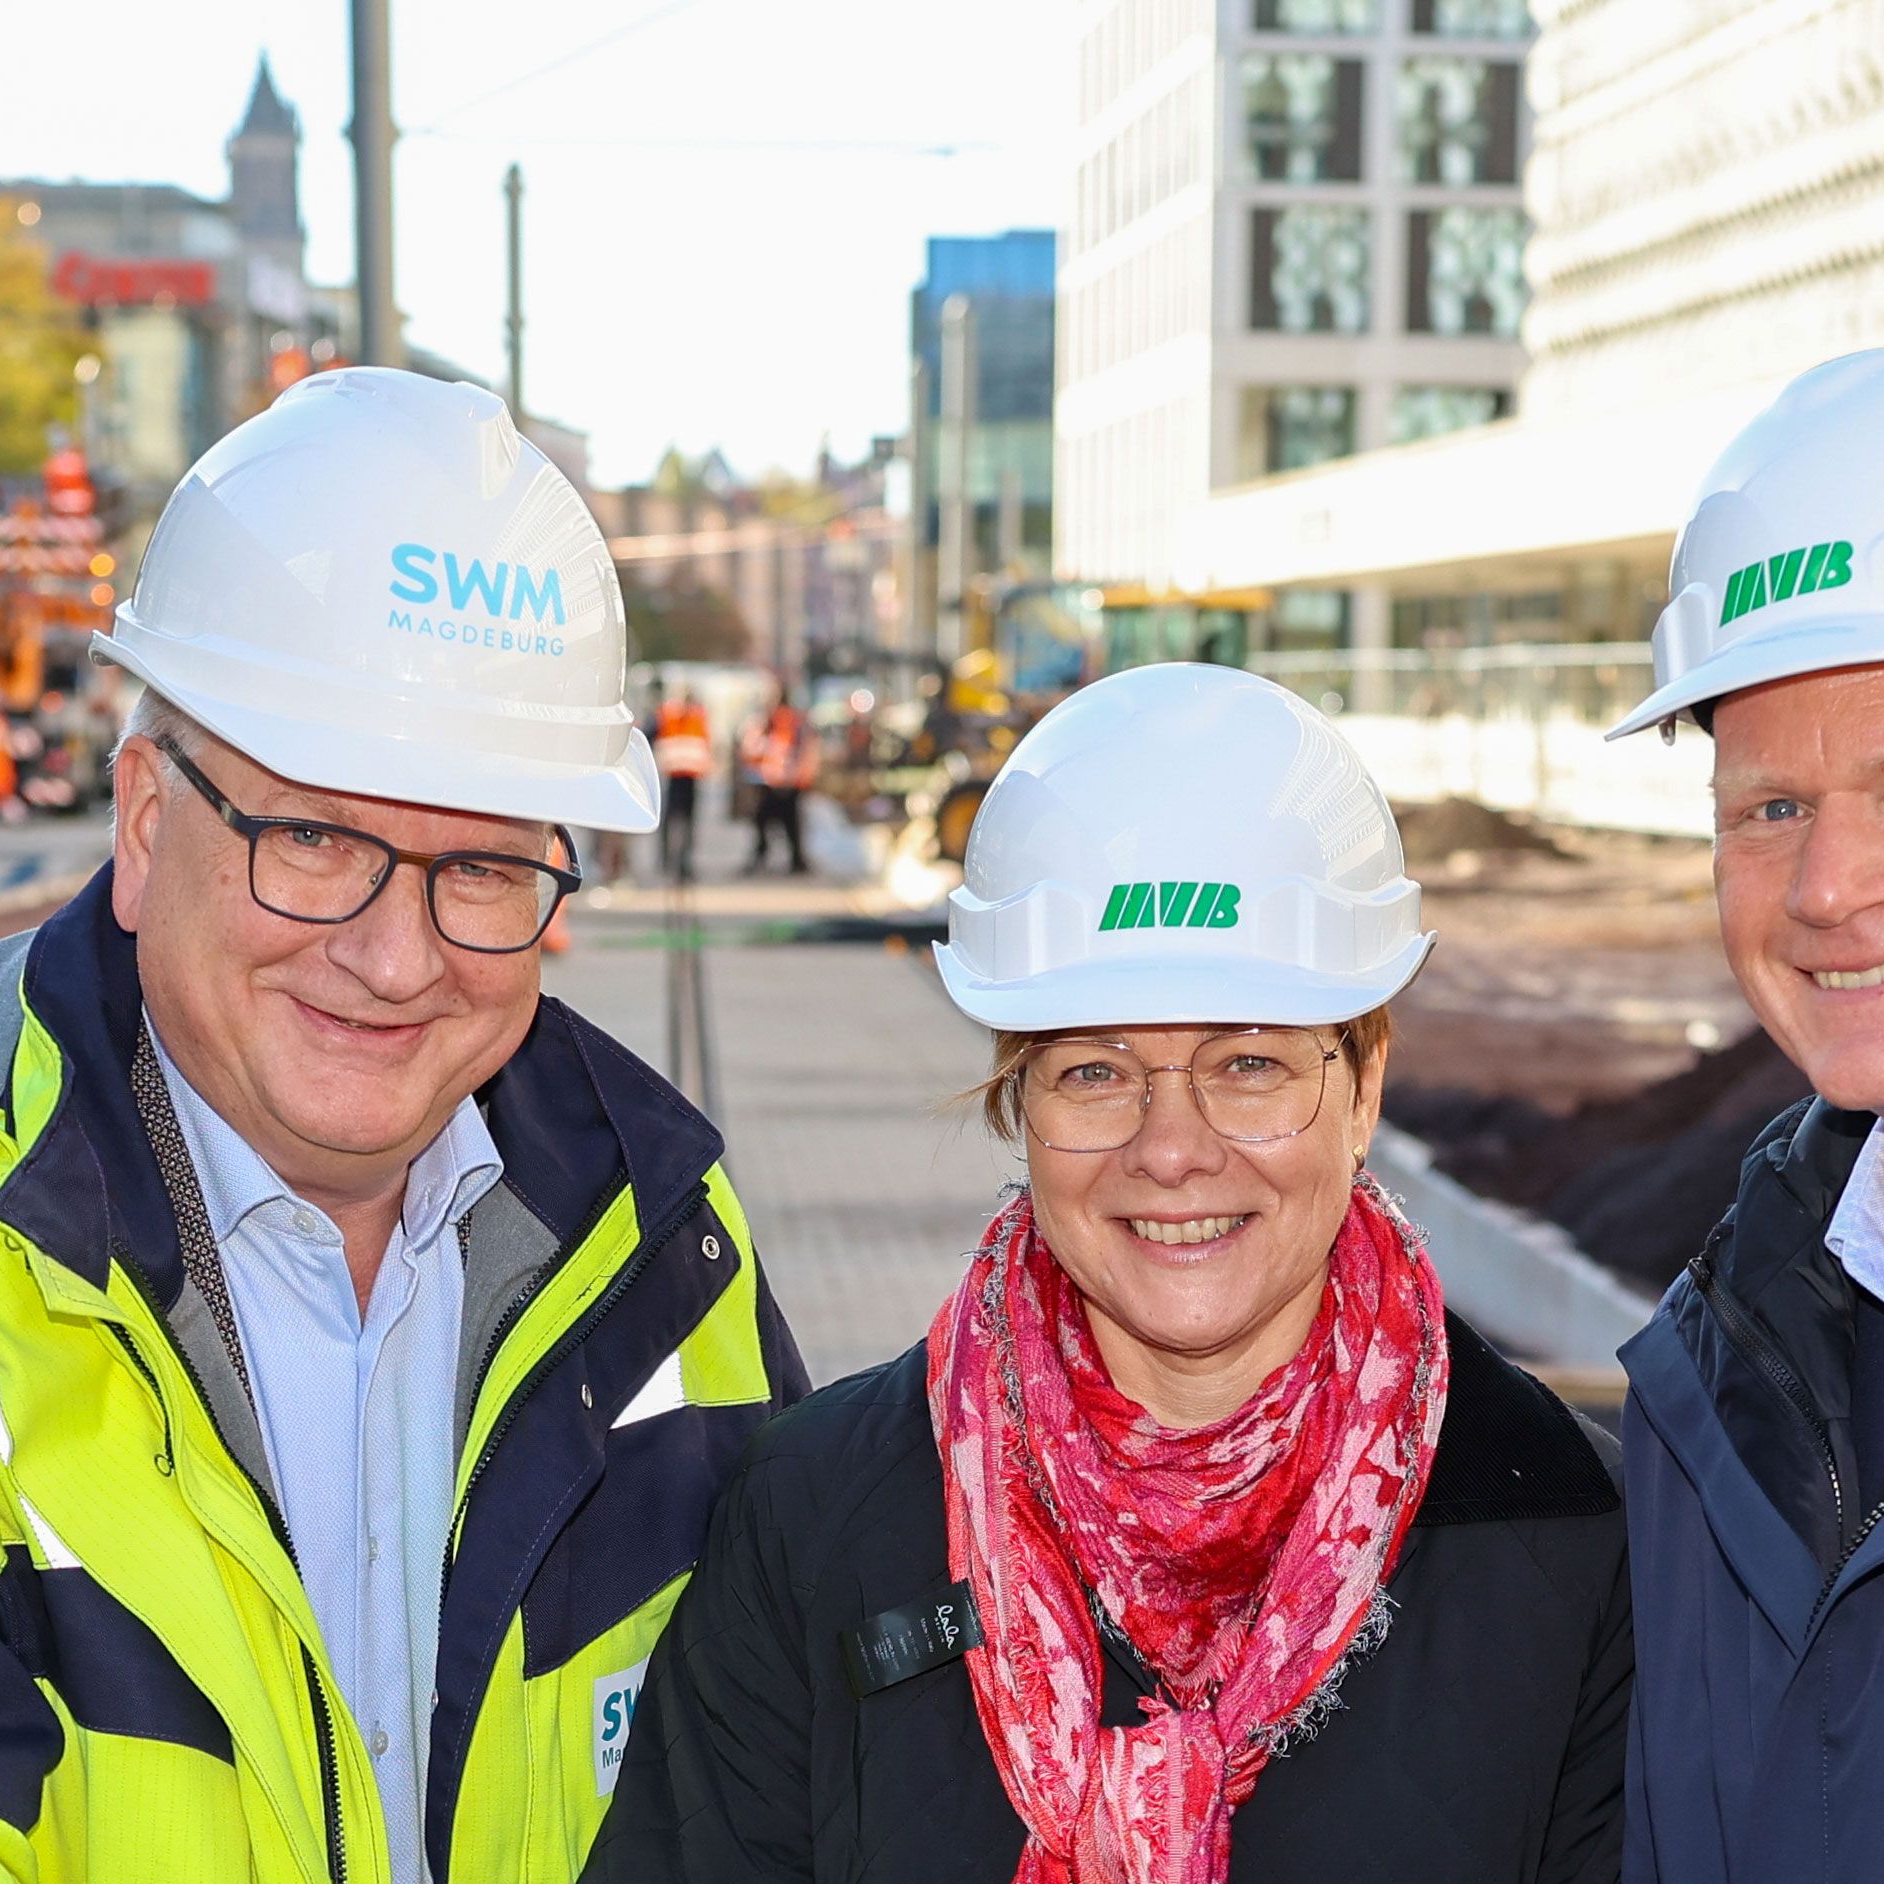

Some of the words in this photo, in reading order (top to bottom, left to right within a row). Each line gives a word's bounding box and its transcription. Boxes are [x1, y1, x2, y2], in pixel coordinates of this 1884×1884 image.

[389, 543, 566, 625] SWM
[1719, 540, 1854, 628] MVB
[388, 609, 565, 656] MAGDEBURG
[1098, 881, 1242, 931] MVB
[935, 1604, 960, 1651] lala
